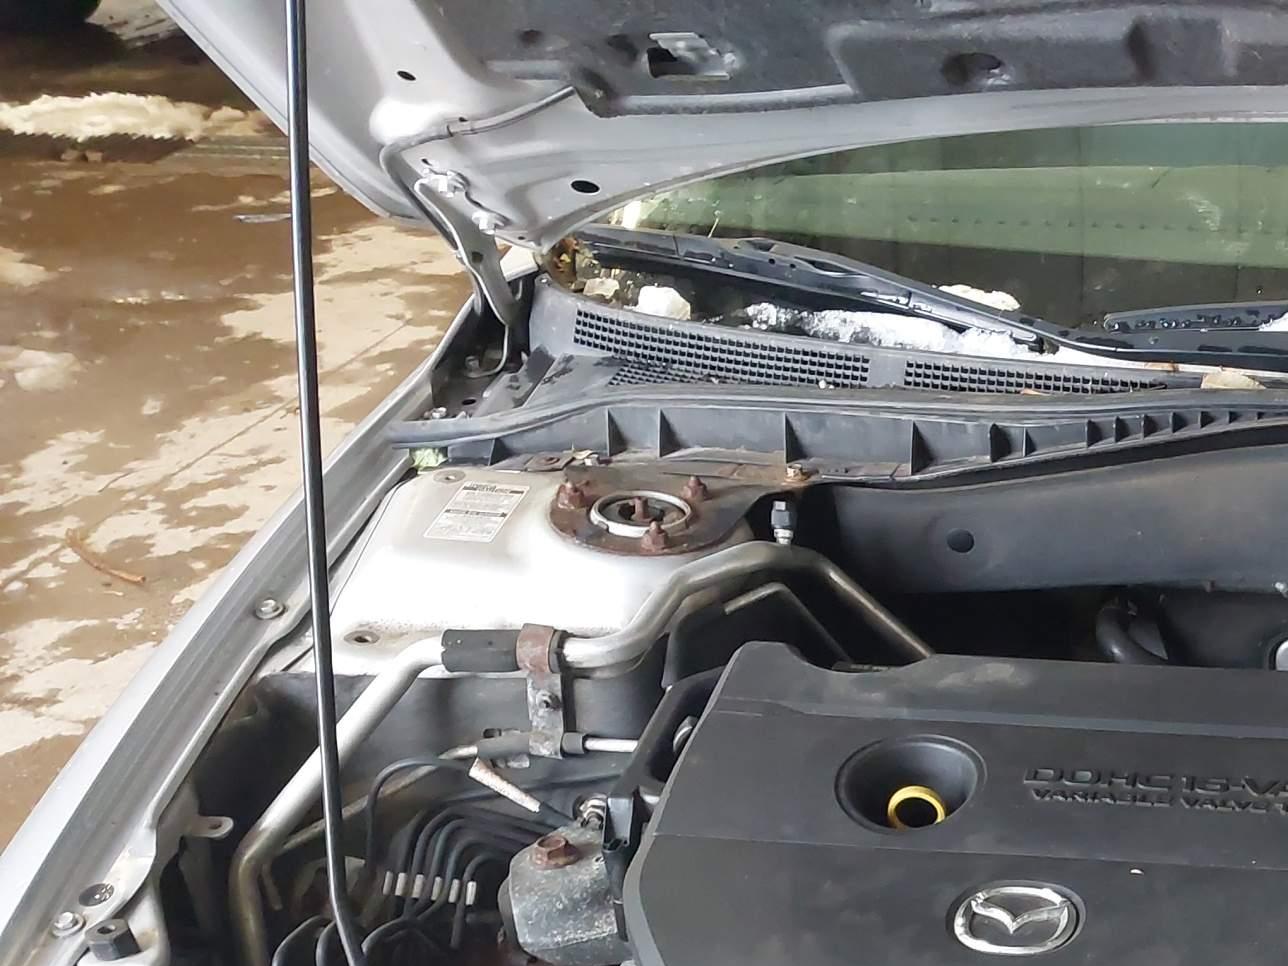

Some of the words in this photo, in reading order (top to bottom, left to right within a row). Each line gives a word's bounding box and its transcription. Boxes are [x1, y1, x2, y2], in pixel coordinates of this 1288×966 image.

[1023, 768, 1174, 792] DOHC
[1030, 787, 1174, 808] VARIABLE
[1179, 797, 1269, 814] VALVE
